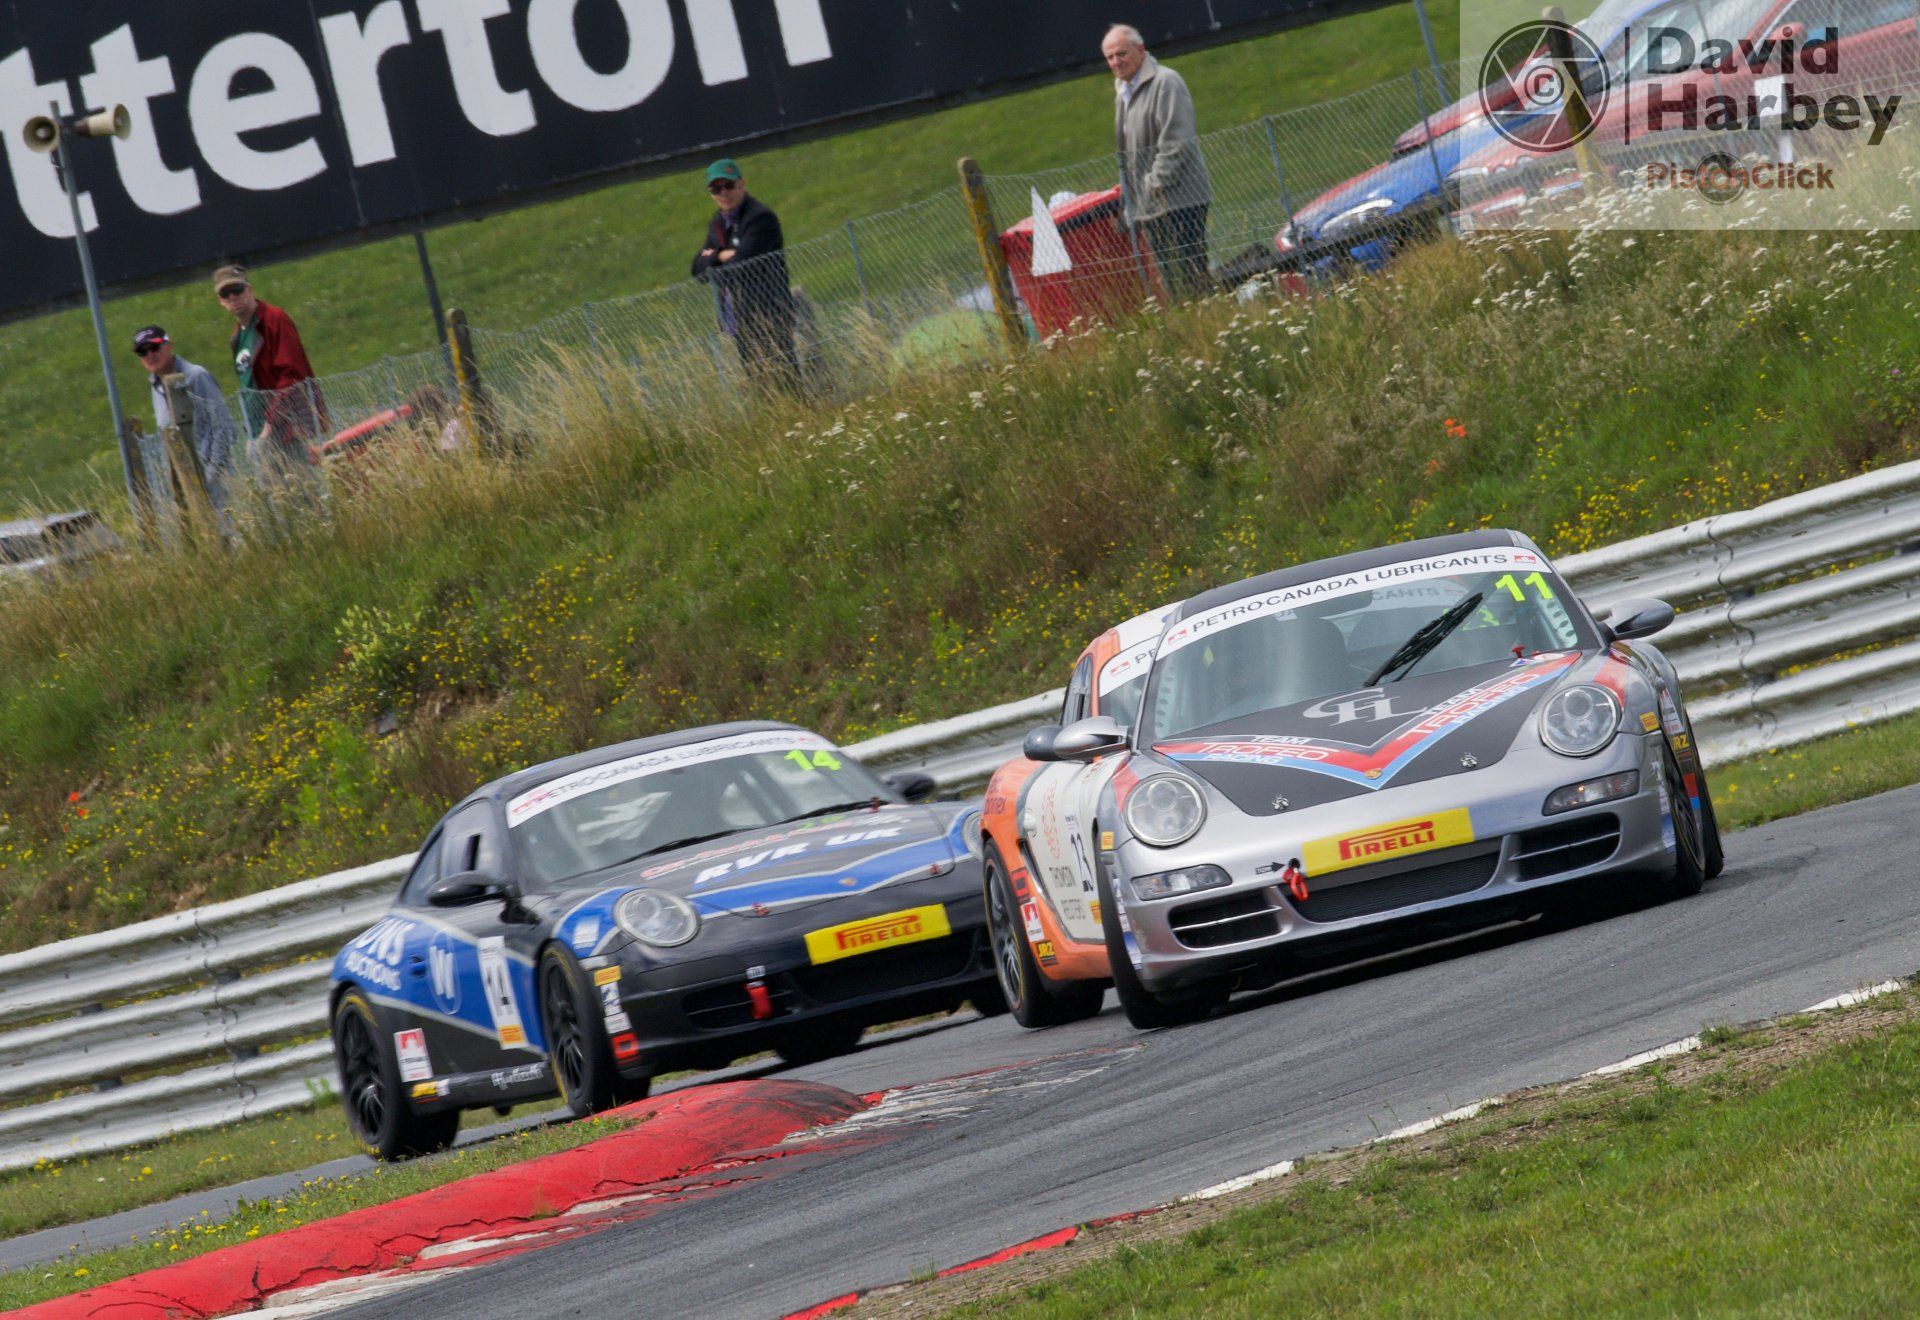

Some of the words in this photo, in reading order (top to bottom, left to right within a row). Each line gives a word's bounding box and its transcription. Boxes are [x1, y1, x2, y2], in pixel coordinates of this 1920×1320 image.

[1365, 552, 1508, 582] LUBRICANTS
[1494, 572, 1554, 602] 11
[1425, 688, 1483, 715] TEAM
[1250, 735, 1313, 745] TEAM
[783, 749, 842, 771] 14
[693, 842, 811, 885] RVR
[825, 827, 904, 847] UK
[1338, 821, 1435, 861] PIRELLI
[835, 915, 923, 950] PIRELLI
